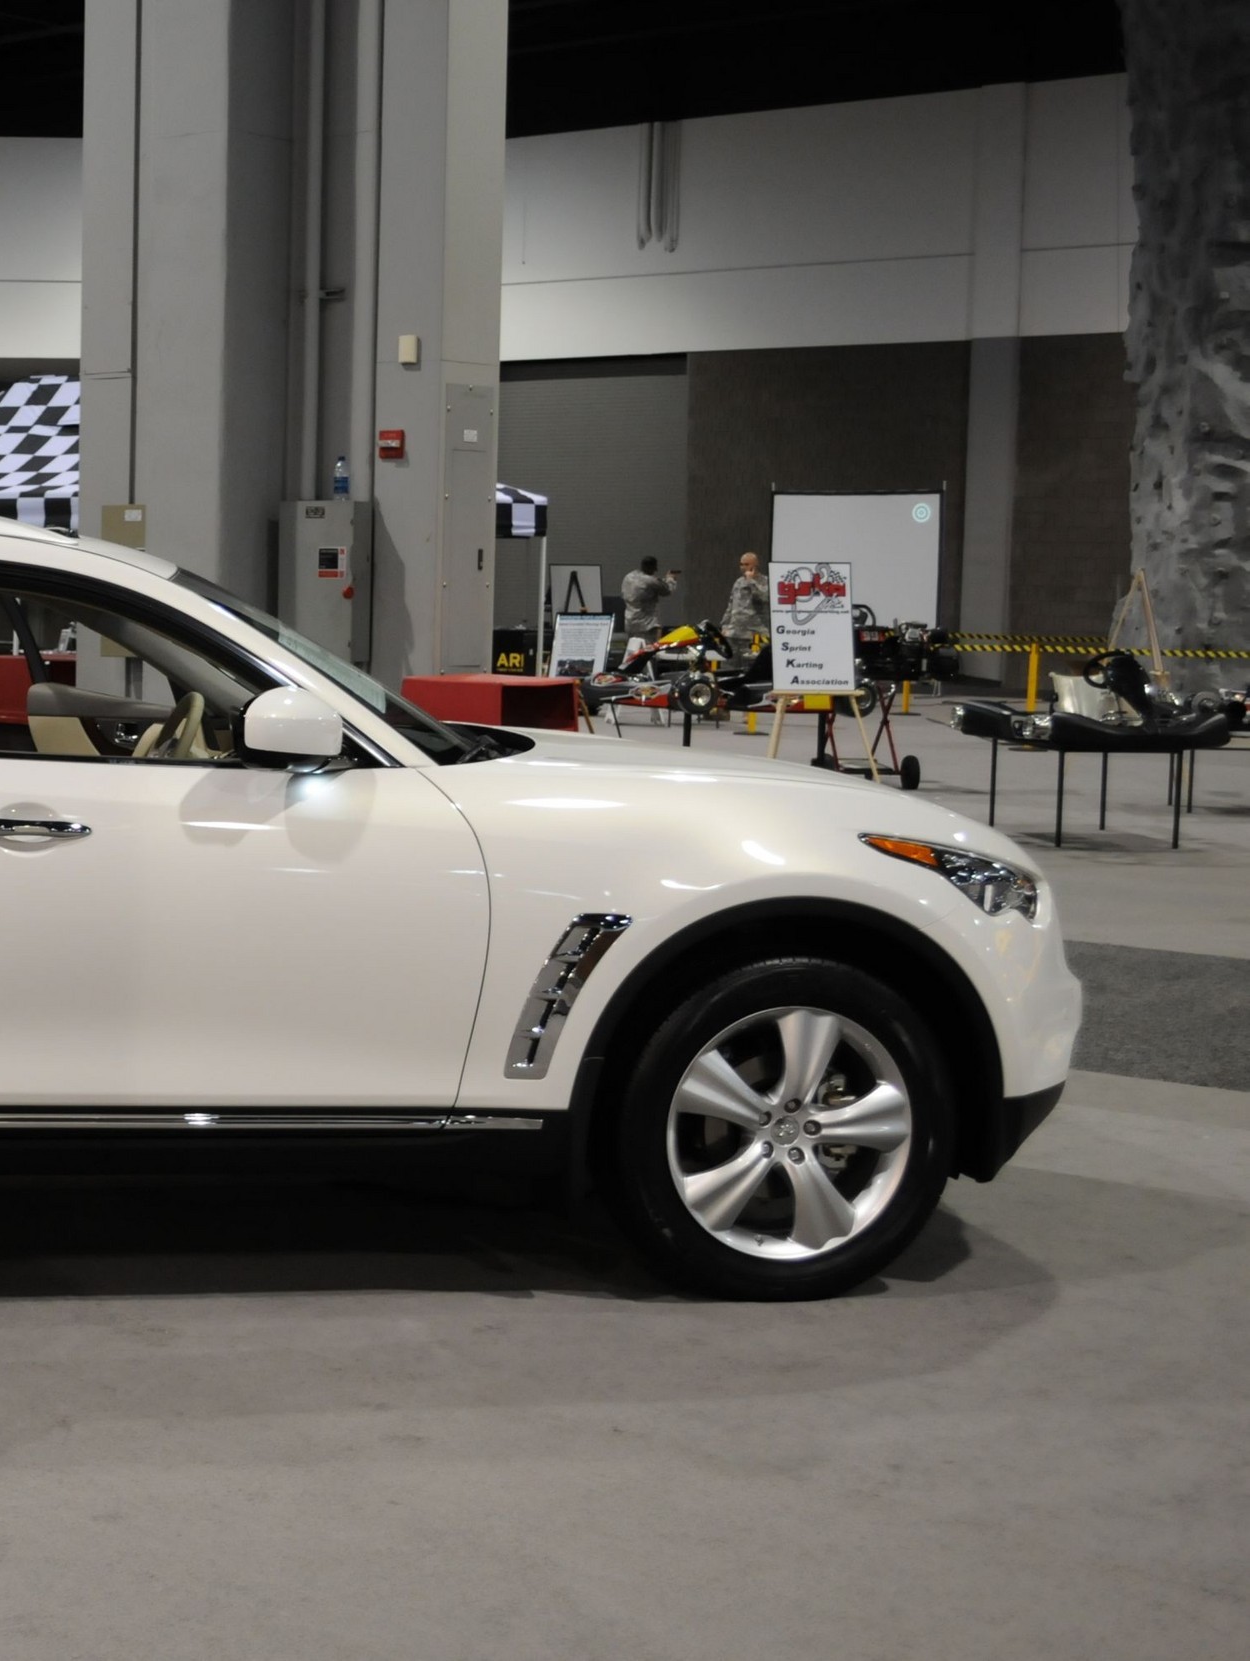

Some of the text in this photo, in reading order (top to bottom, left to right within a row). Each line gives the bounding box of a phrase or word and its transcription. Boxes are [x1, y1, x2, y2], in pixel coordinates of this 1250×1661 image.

[776, 625, 815, 636] Georgia
[781, 642, 811, 652] Sprint
[786, 659, 823, 669] Karting
[790, 676, 849, 685] Association
